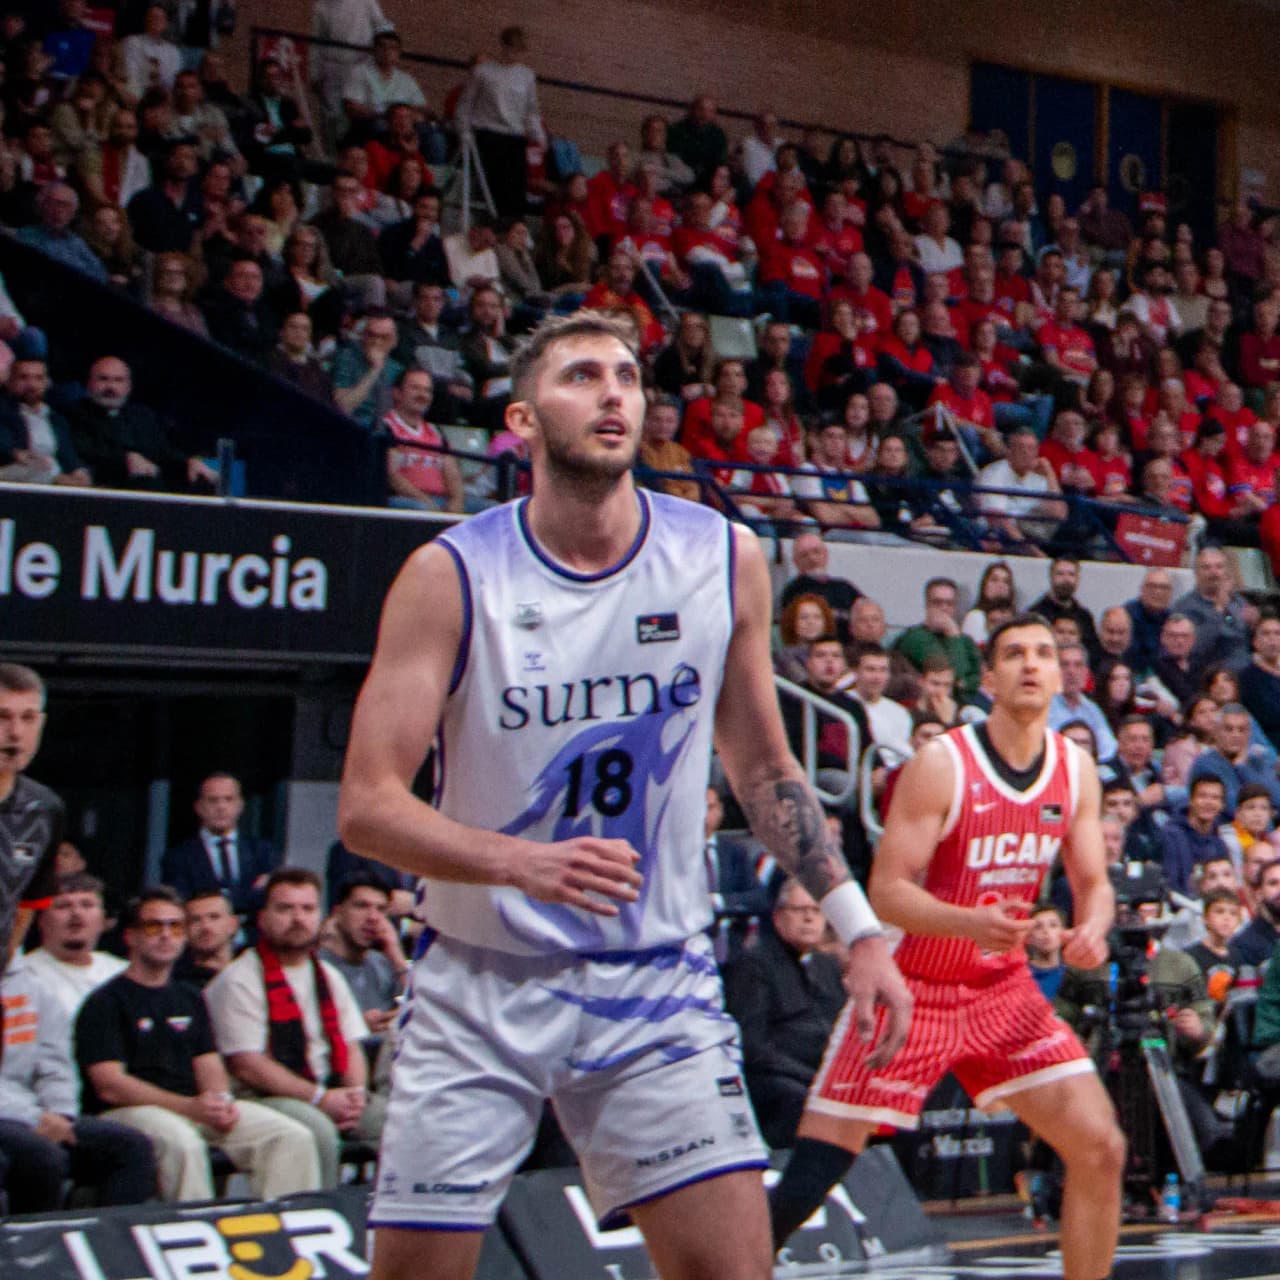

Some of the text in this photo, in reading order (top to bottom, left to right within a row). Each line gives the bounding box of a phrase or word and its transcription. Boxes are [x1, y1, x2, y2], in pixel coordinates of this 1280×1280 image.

[80, 525, 328, 612] Murcia
[561, 748, 634, 818] 18
[967, 832, 1061, 871] UCAM
[636, 1135, 716, 1169] NISSAN
